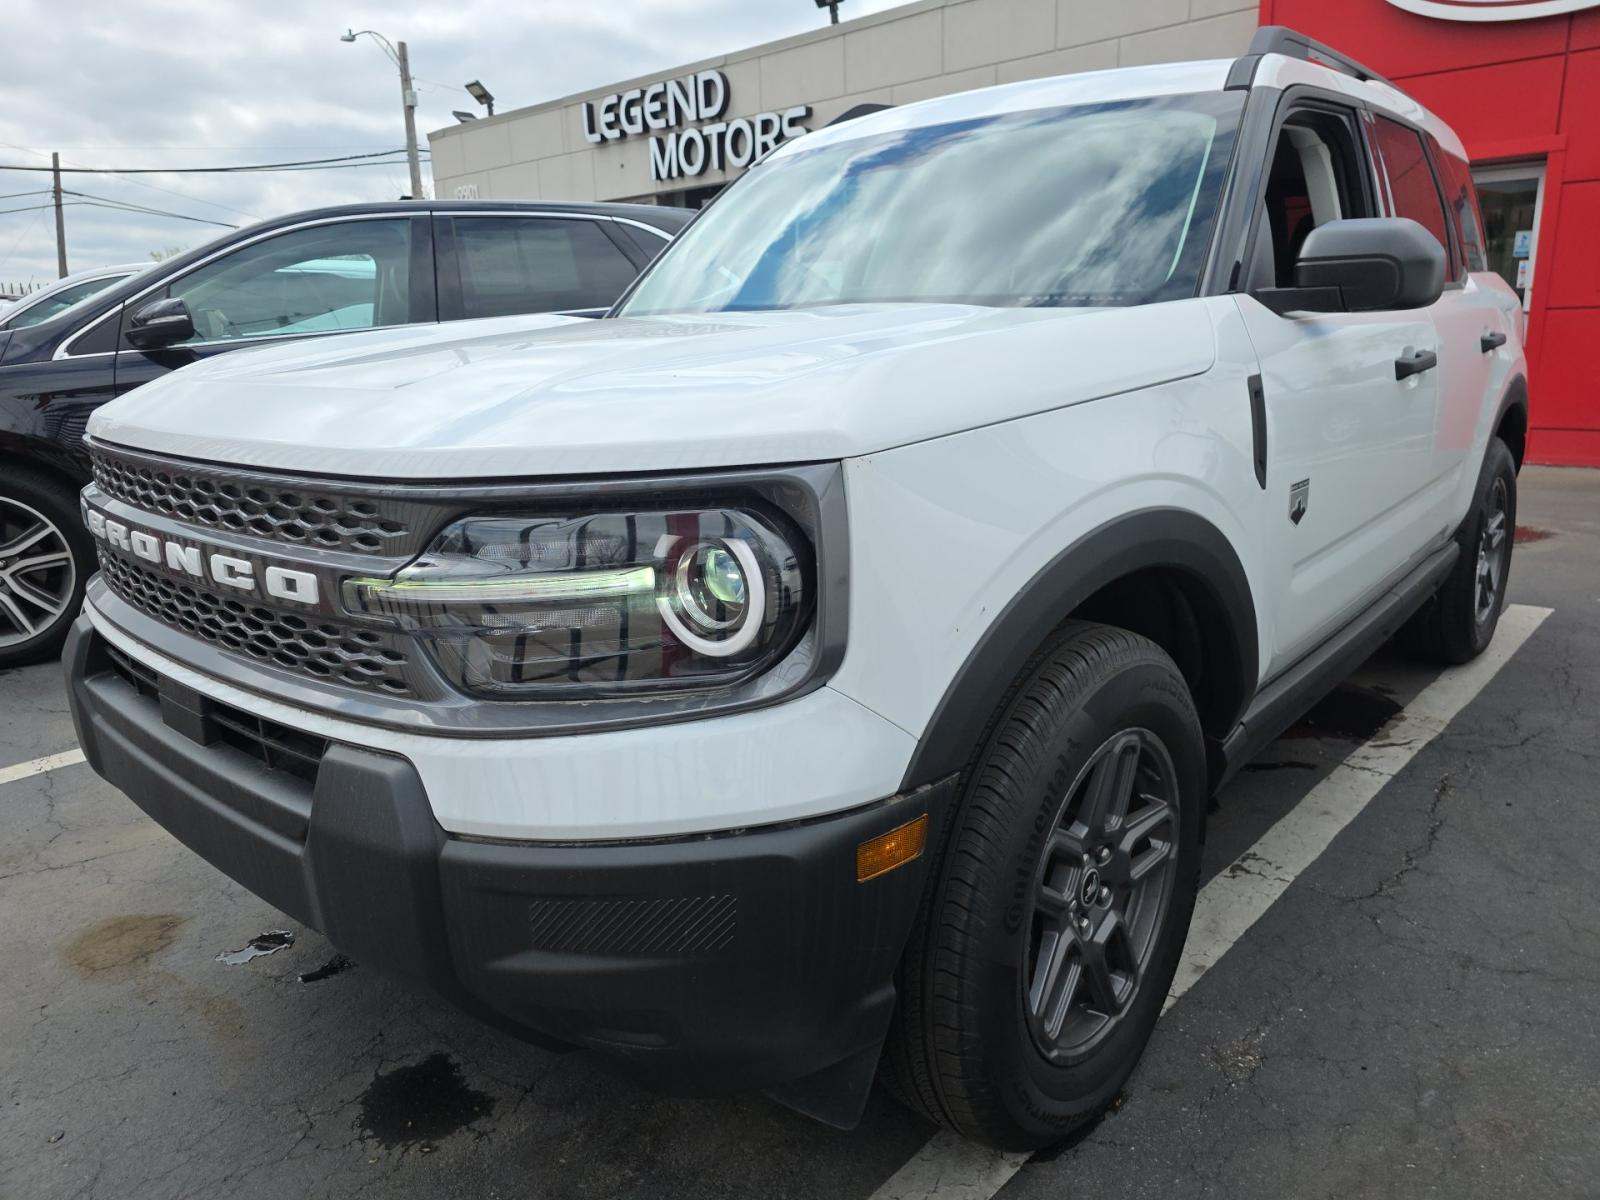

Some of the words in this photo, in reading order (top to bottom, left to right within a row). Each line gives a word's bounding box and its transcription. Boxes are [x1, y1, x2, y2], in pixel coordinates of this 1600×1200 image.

[581, 69, 727, 144] LEGEND
[649, 105, 809, 181] MOTORS
[88, 508, 320, 605] BRONCO
